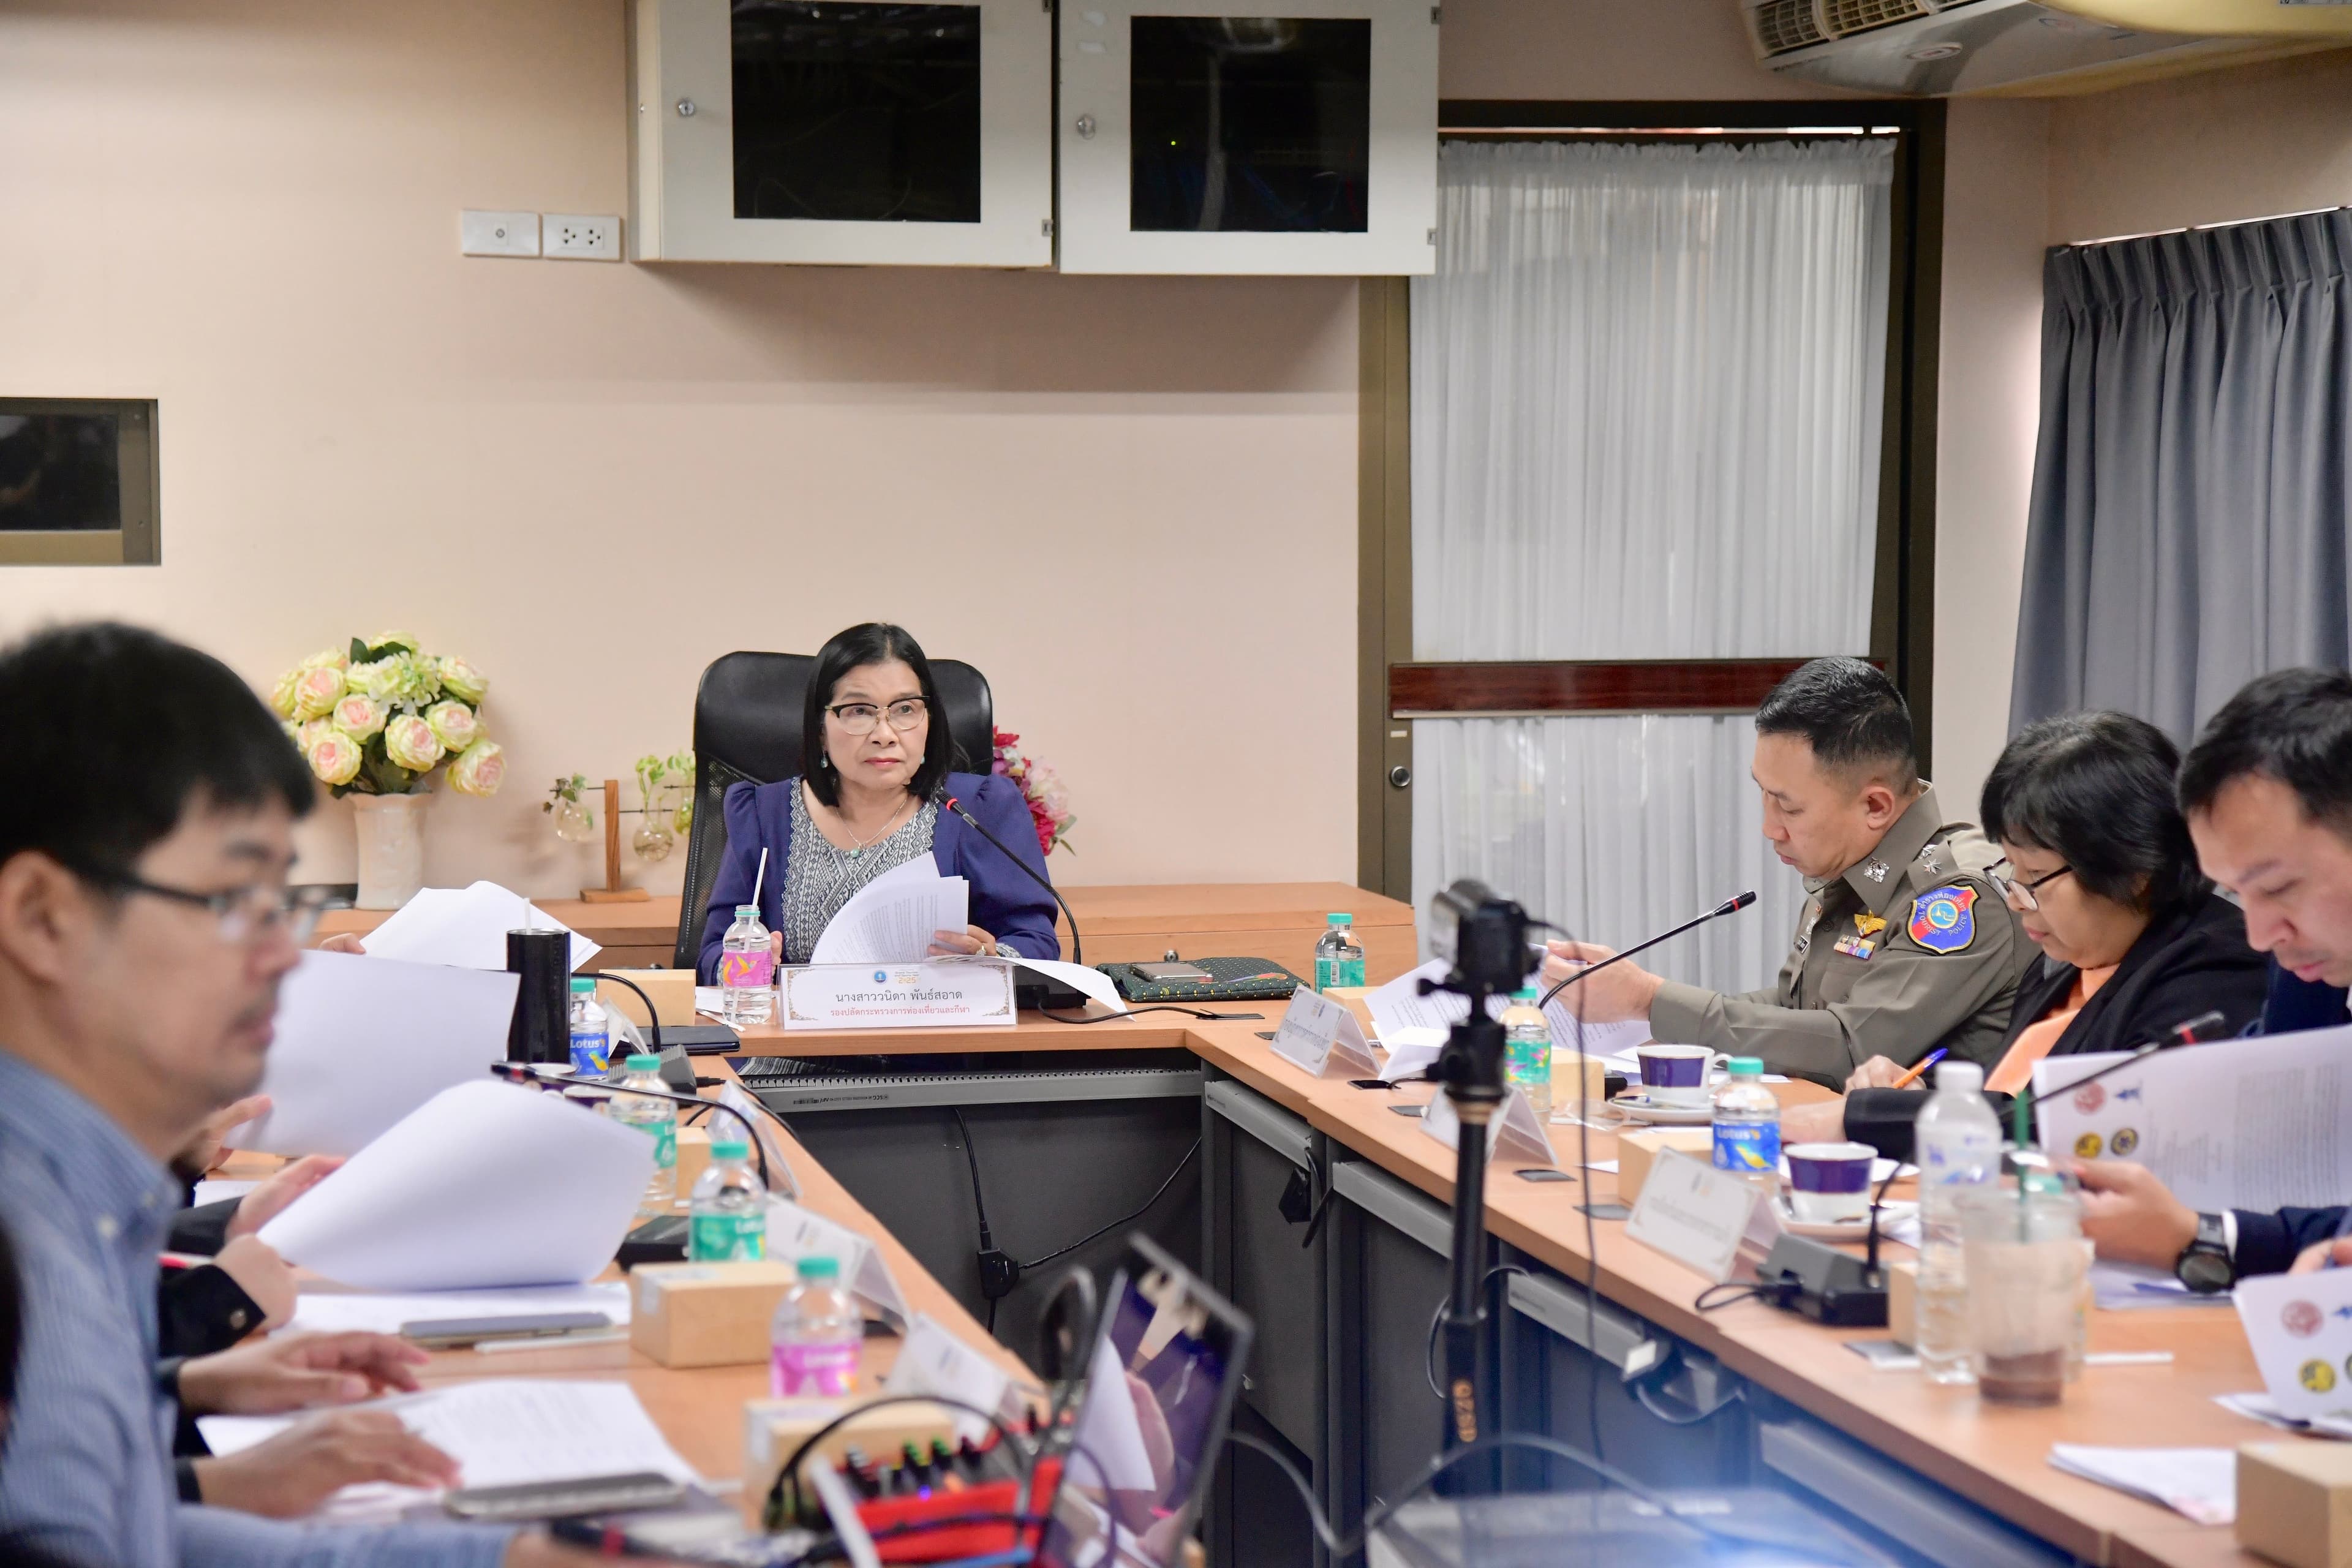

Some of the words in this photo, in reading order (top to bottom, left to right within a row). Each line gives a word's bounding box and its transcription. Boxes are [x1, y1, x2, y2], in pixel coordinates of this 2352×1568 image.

[1918, 910, 1942, 936] TOURIST
[1948, 914, 1967, 937] POLICE
[835, 990, 906, 1002] นางสาววนิดา
